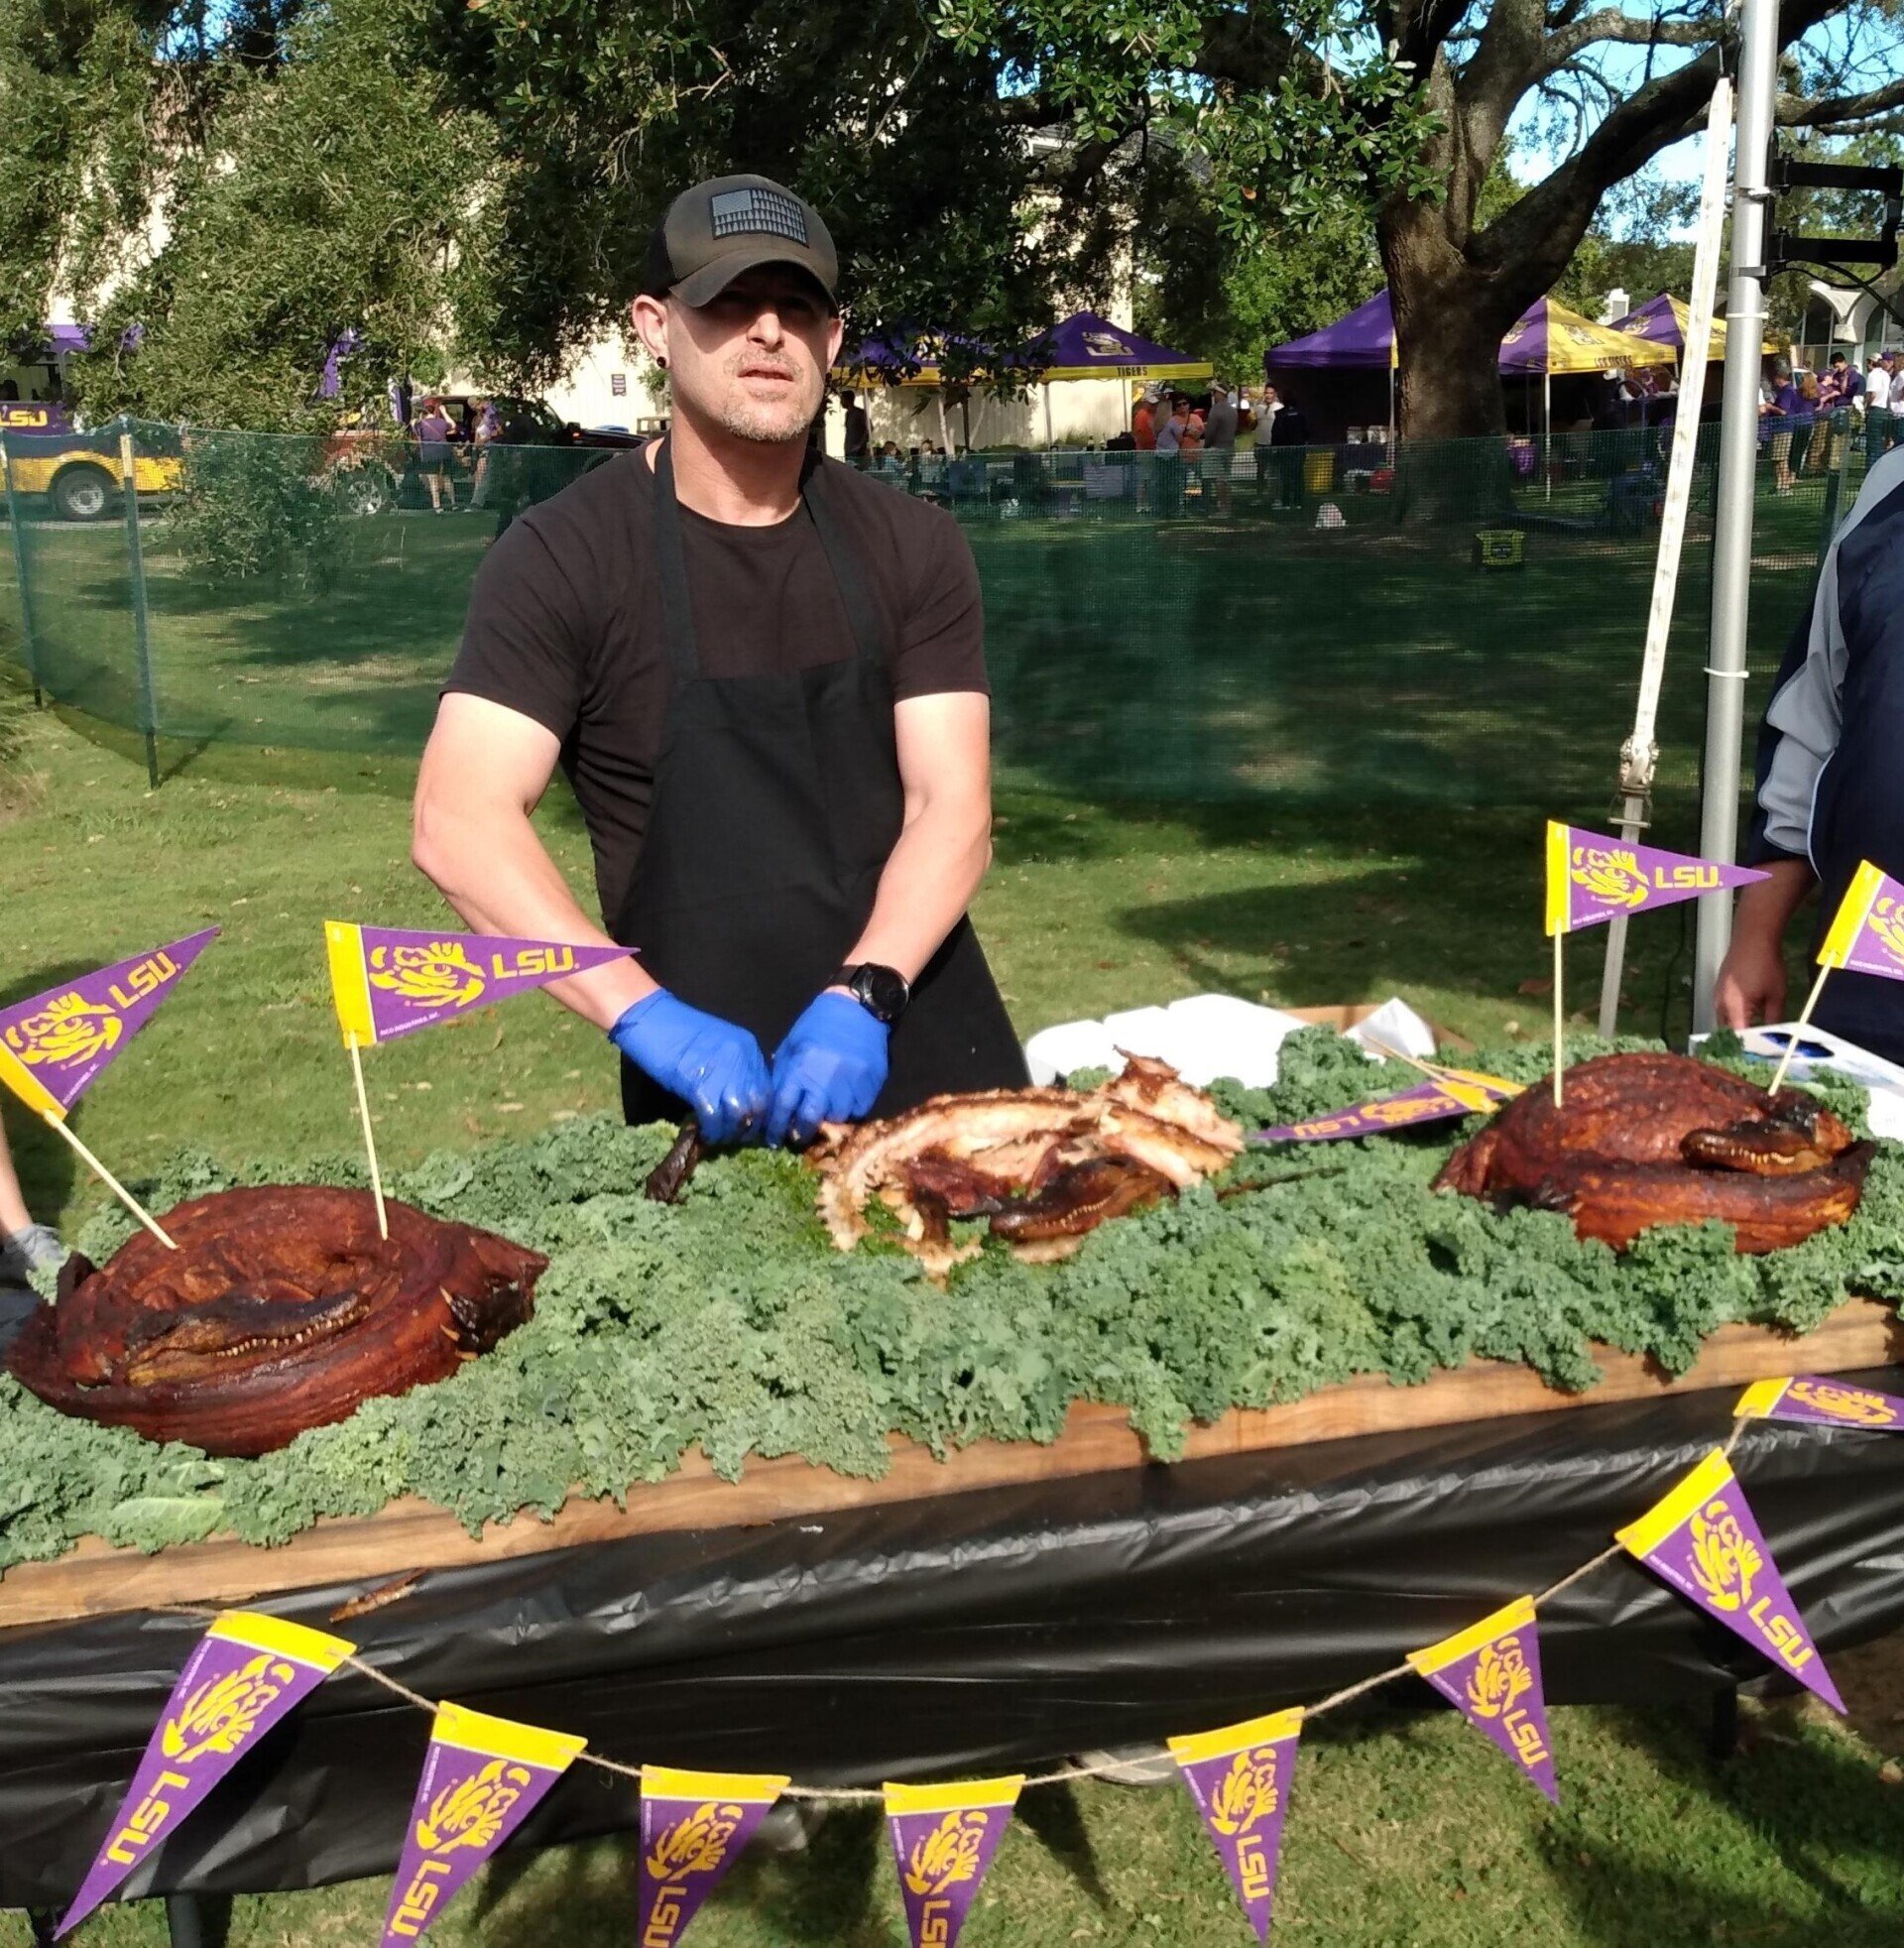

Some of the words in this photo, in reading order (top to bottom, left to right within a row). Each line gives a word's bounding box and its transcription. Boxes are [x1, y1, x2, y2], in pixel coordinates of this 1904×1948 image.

[1117, 366, 1148, 377] TIGERS
[1655, 866, 1719, 889] LSU
[108, 951, 177, 1010] LSU
[492, 946, 574, 979] LSU
[1293, 1115, 1360, 1137] LSU
[1748, 1596, 1814, 1668] LSU
[1502, 1708, 1549, 1765] LSU
[106, 1770, 190, 1865] LSU
[1236, 1835, 1270, 1899] LSU
[391, 1859, 451, 1937] LSU
[643, 1887, 687, 1948] LSU
